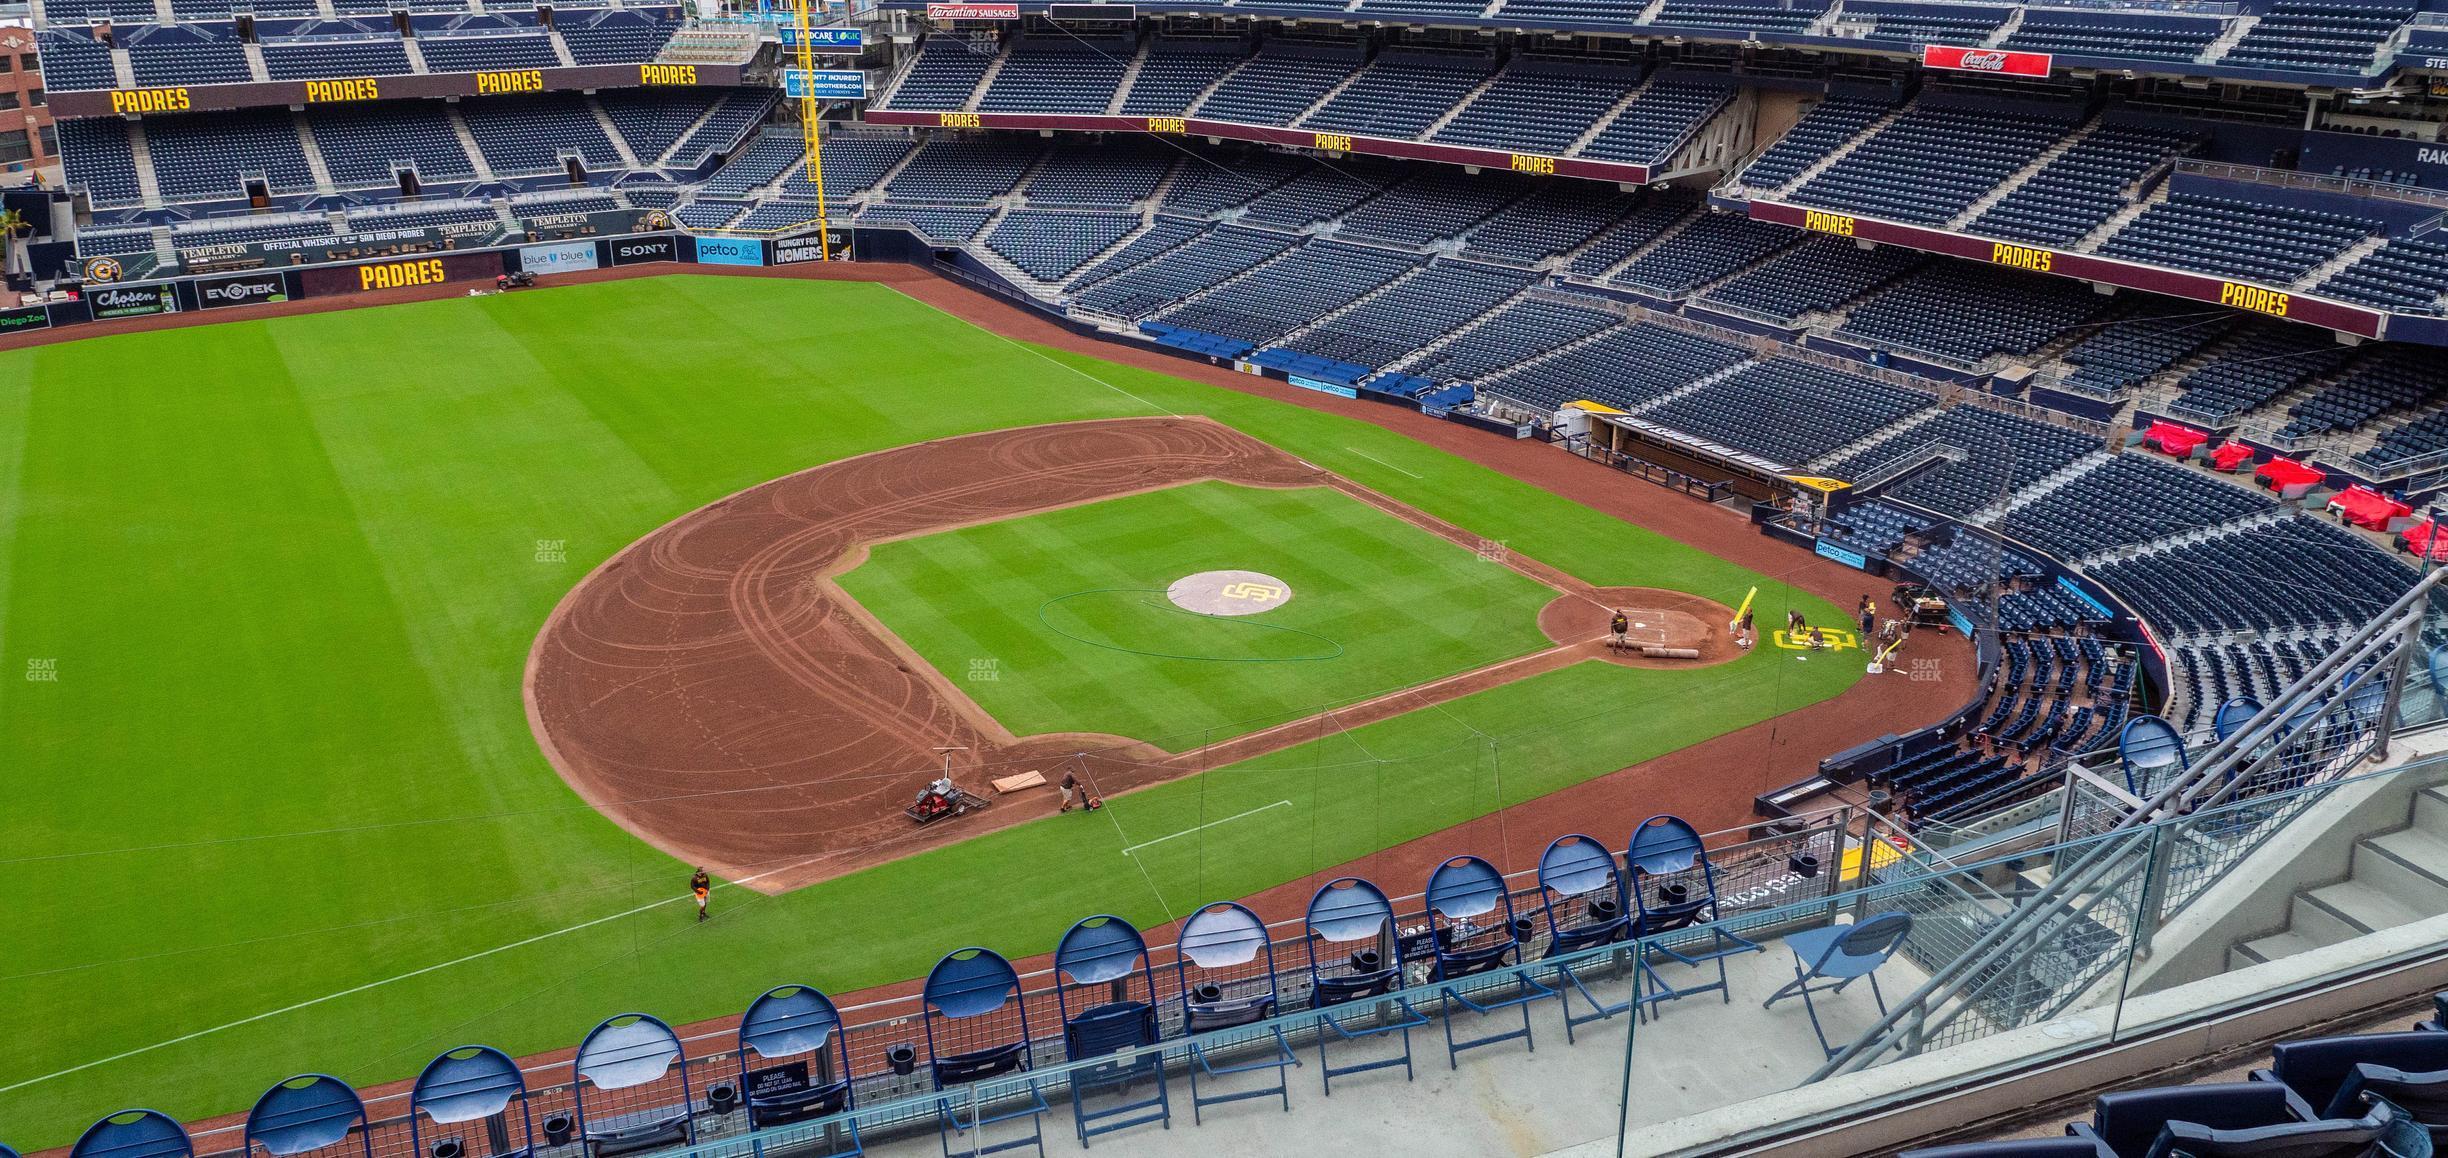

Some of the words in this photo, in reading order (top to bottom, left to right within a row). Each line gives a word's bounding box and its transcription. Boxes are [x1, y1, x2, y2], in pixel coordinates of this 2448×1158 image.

[930, 6, 976, 17] Tarantino
[979, 9, 1016, 17] SAUSAGES
[640, 65, 696, 84] PADRES
[477, 71, 543, 93] PADRES
[305, 79, 378, 102] PADRES
[111, 89, 190, 112] PADRES
[941, 114, 980, 127] PADRES
[1148, 118, 1185, 132] PADRES
[1315, 134, 1350, 151] PADRES
[1512, 155, 1554, 173] PADRES
[532, 214, 587, 227] TEMPLETON
[1805, 210, 1854, 236] PADRES
[438, 222, 496, 235] TEMPLETON
[263, 240, 301, 250] OFFICIAL
[303, 237, 340, 247] WHISKEY
[360, 234, 374, 242] SAN
[376, 232, 396, 240] DIEGO
[398, 229, 424, 238] PADRES
[778, 238, 804, 248] HUNGRY
[806, 237, 818, 245] FOR
[827, 234, 841, 244] 322
[181, 245, 247, 259] TEMPLETON
[561, 252, 583, 260] blue
[620, 244, 668, 256] SONY
[701, 244, 738, 257] petco
[776, 246, 822, 263] HOMERS
[1993, 243, 2052, 271] PADRES
[524, 255, 547, 264] blue
[359, 259, 445, 290] PADRES
[97, 290, 156, 306] Chosen
[206, 283, 277, 300] EVOTEK
[2221, 282, 2288, 316] PADRES
[0, 317, 26, 326] Diego
[28, 314, 46, 322] Zoo
[1323, 384, 1339, 392] petco
[1817, 544, 1839, 556] petco
[763, 1072, 786, 1082] PLEASE
